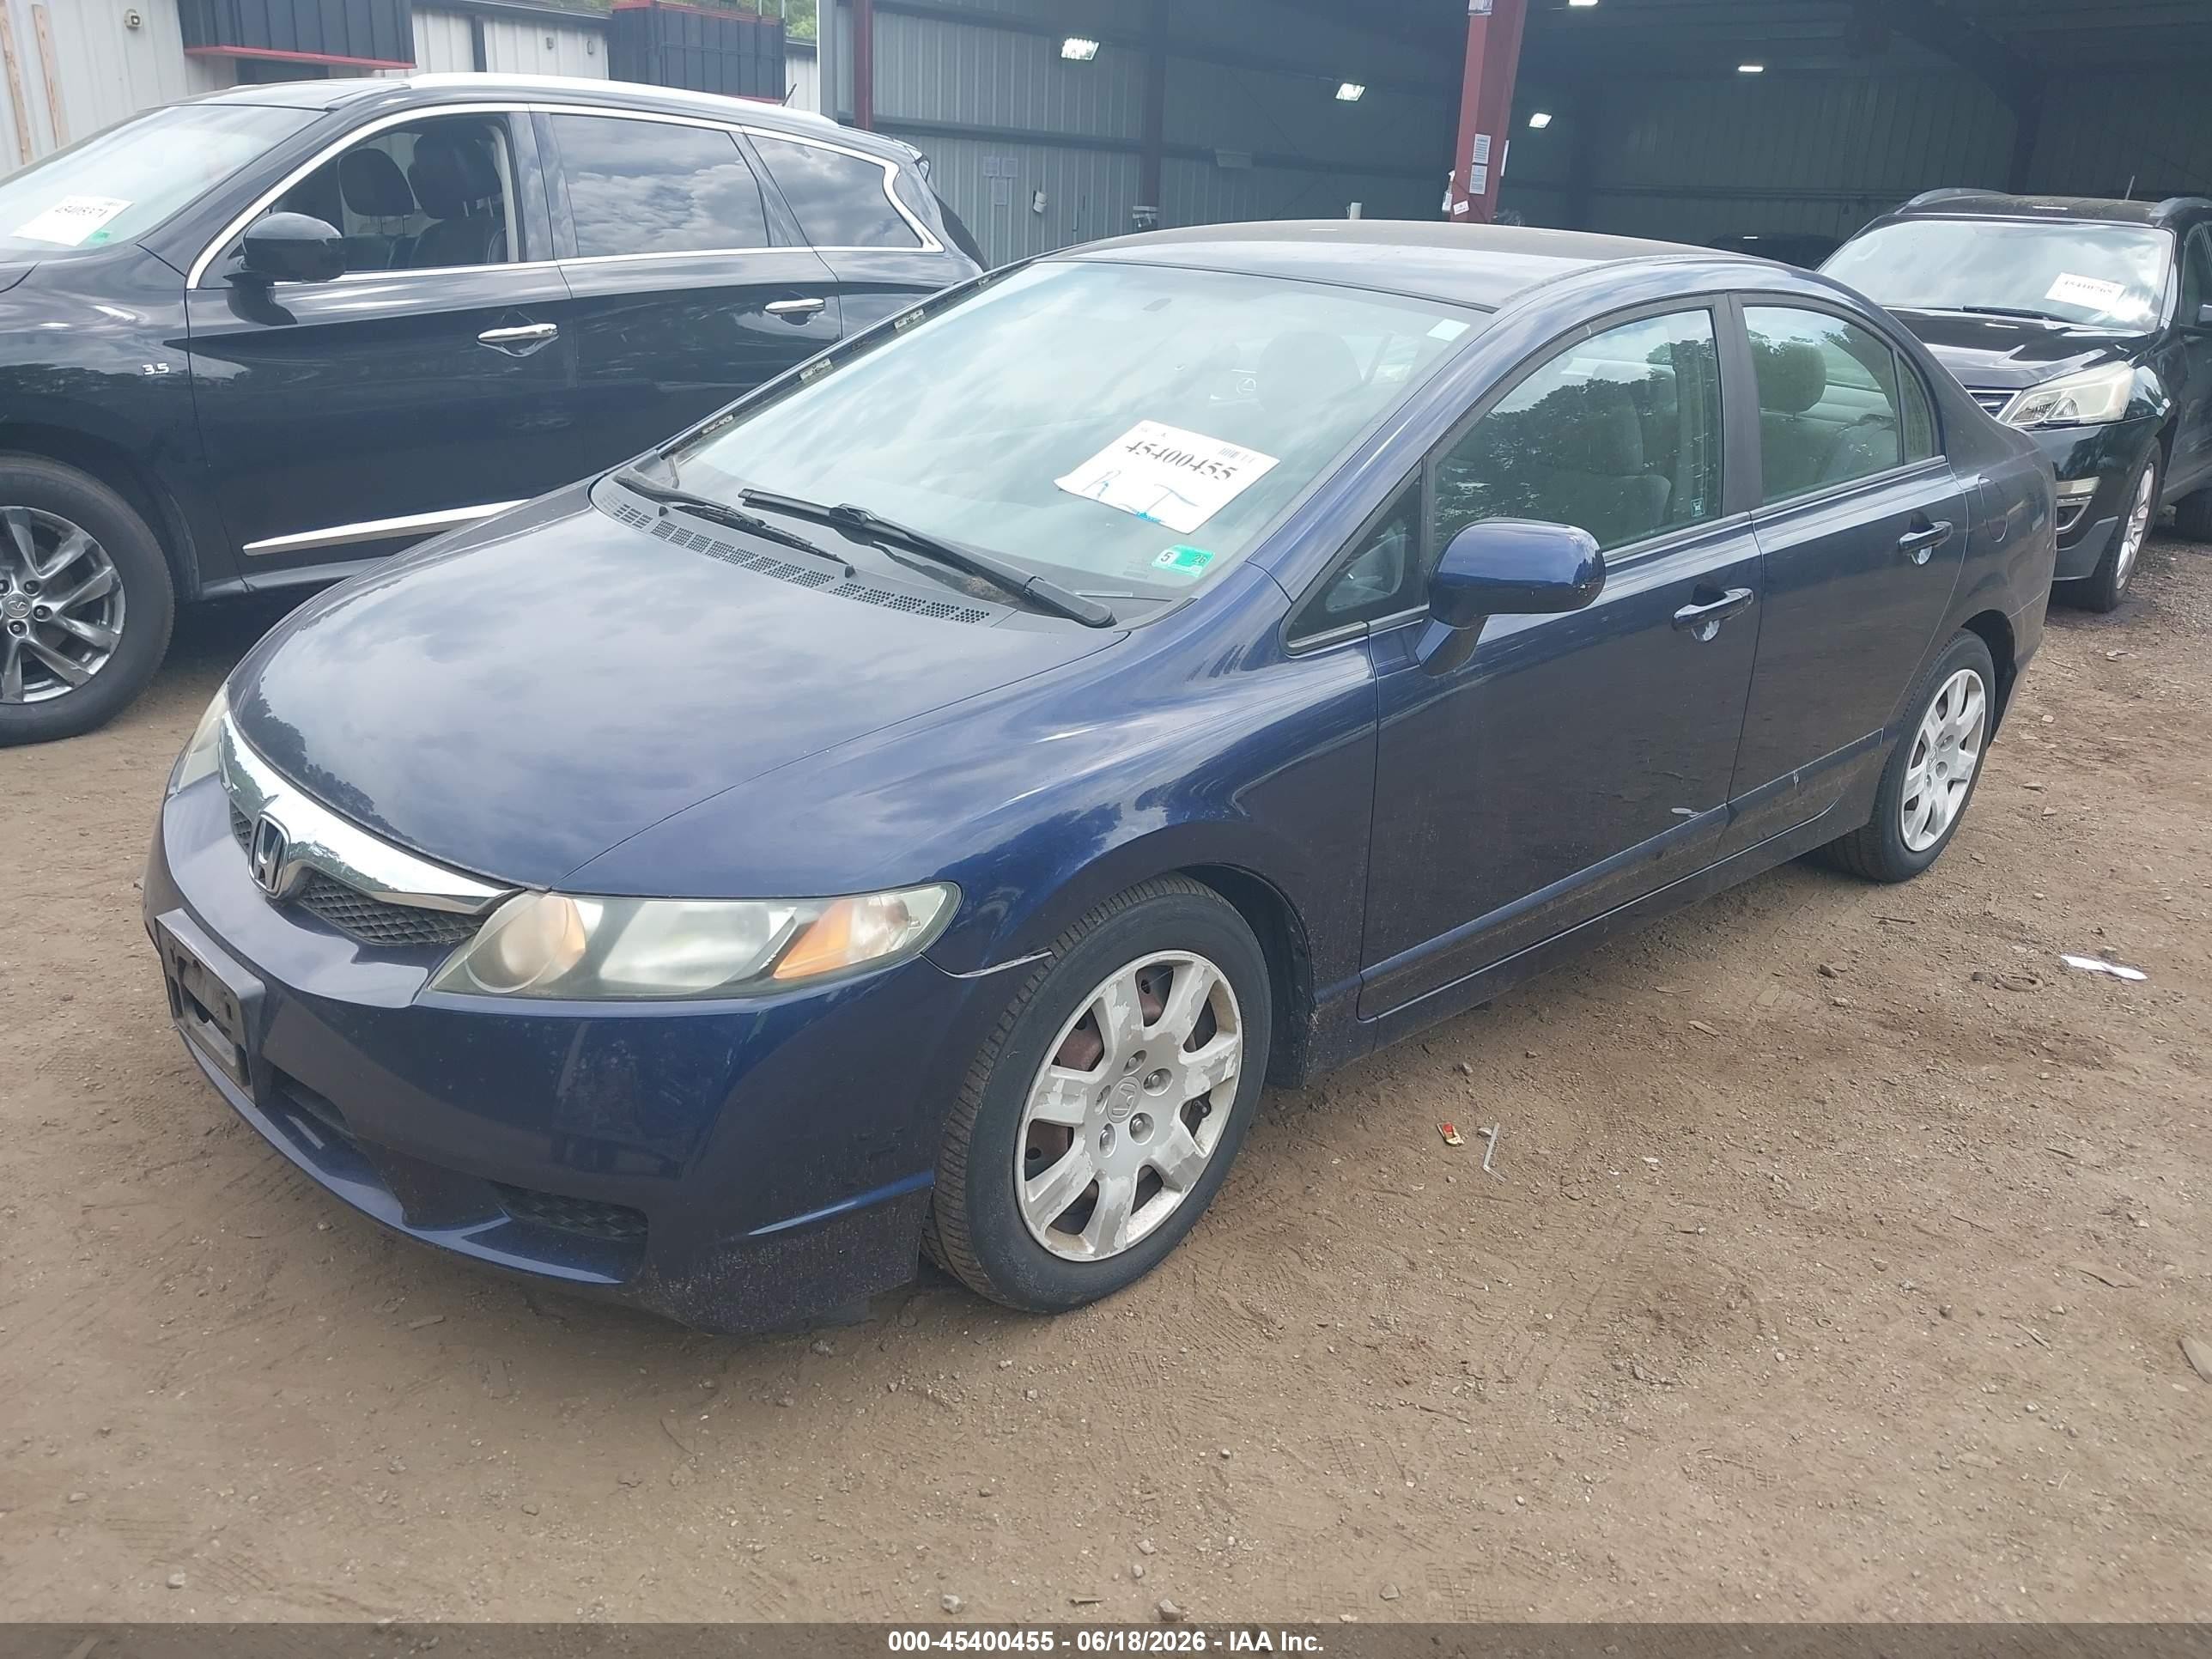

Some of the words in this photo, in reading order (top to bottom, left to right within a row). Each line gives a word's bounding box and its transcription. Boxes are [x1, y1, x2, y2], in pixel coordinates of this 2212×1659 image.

[142, 362, 170, 375] 3.5
[1125, 441, 1238, 481] 45400455
[1160, 551, 1174, 562] 5
